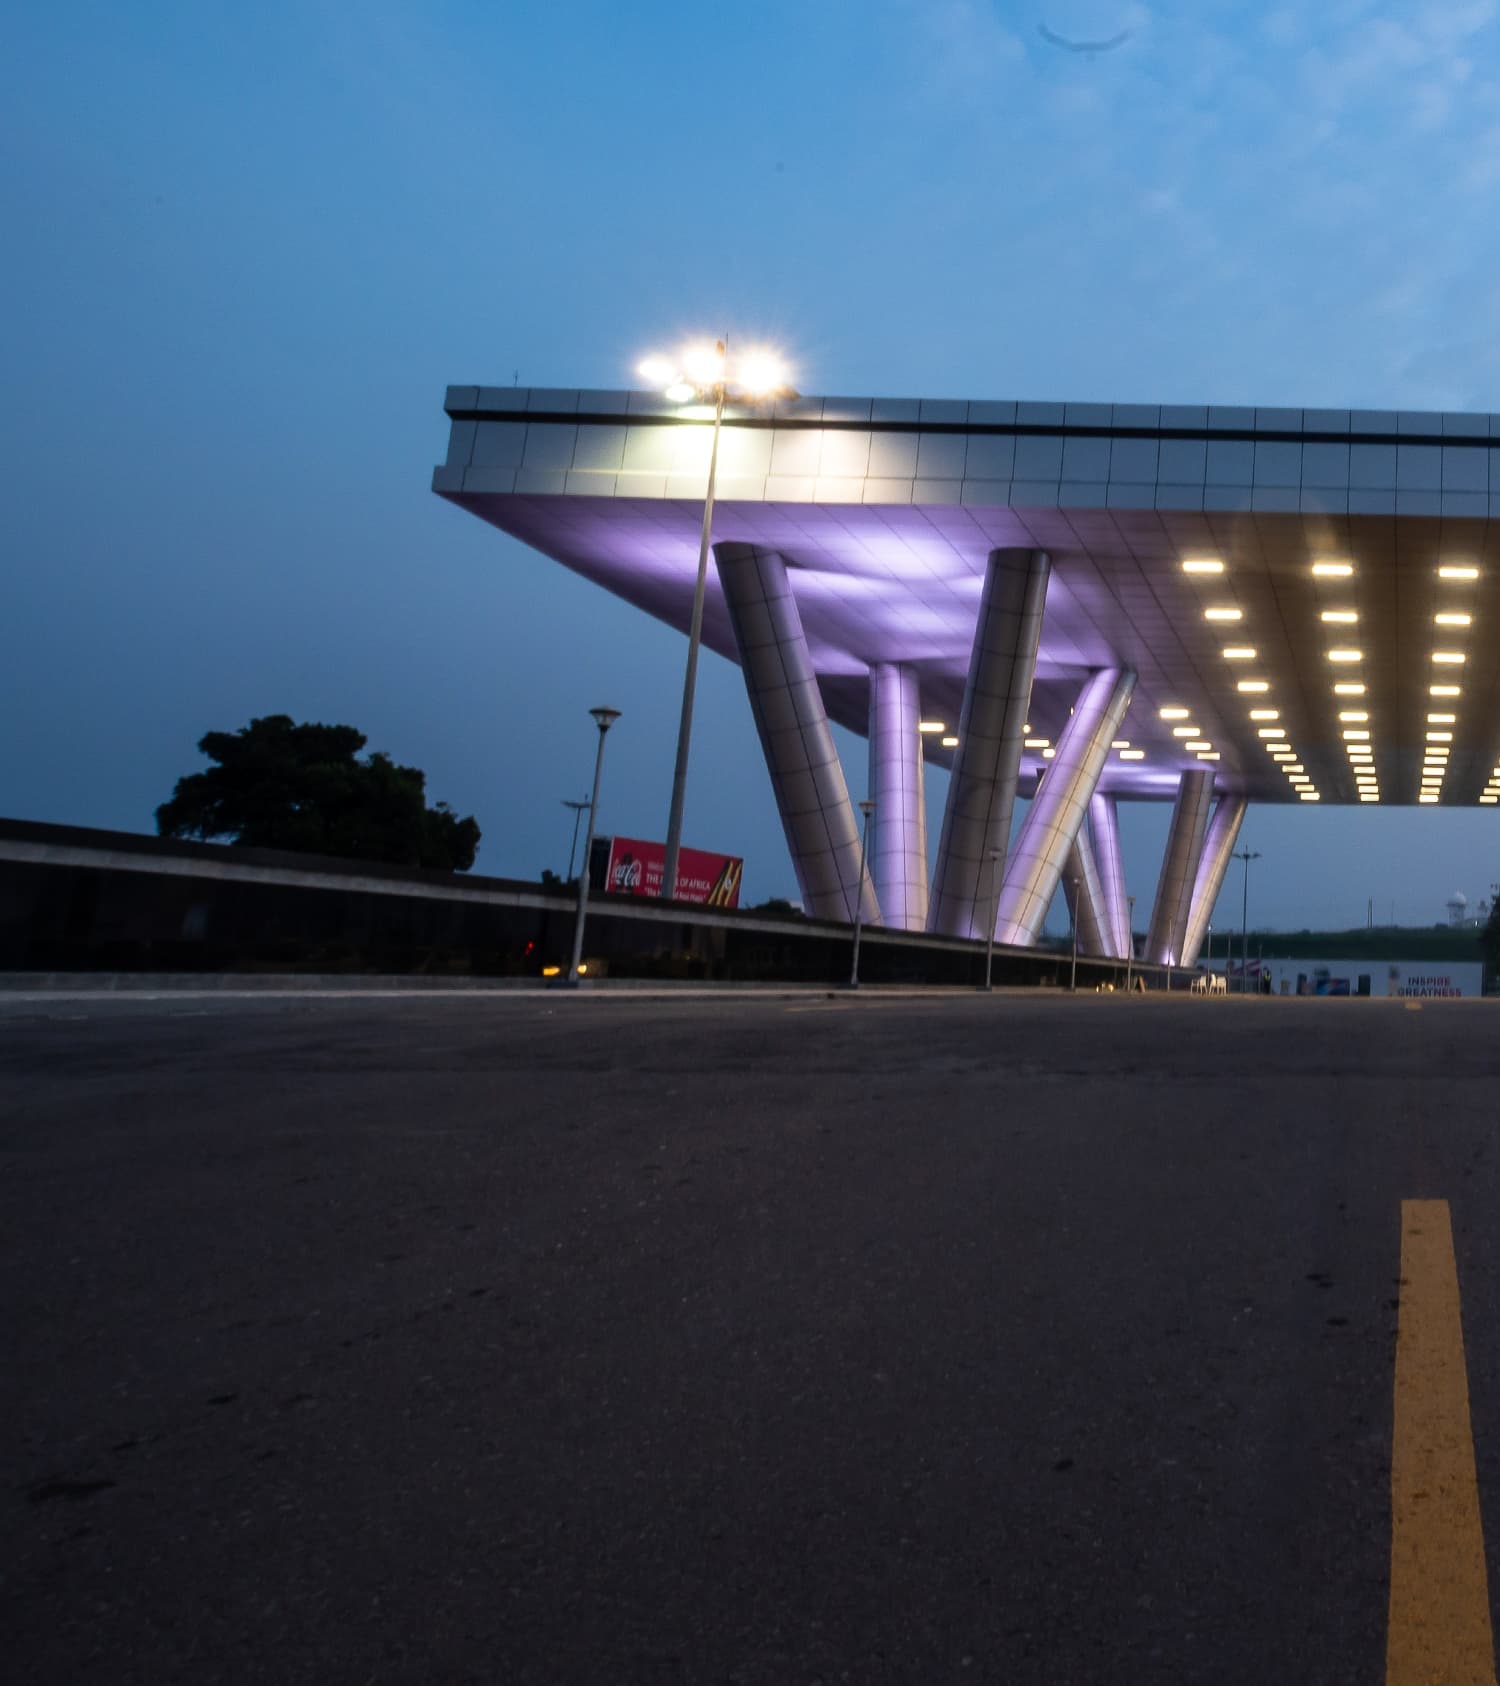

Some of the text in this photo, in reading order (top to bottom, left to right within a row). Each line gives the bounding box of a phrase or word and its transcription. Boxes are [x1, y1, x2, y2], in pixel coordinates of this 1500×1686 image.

[646, 872, 659, 885] THE
[680, 877, 689, 888] OF
[688, 879, 711, 890] AFRICA
[1408, 976, 1450, 986] INSPIRE
[1398, 986, 1462, 997] GREATNESS
